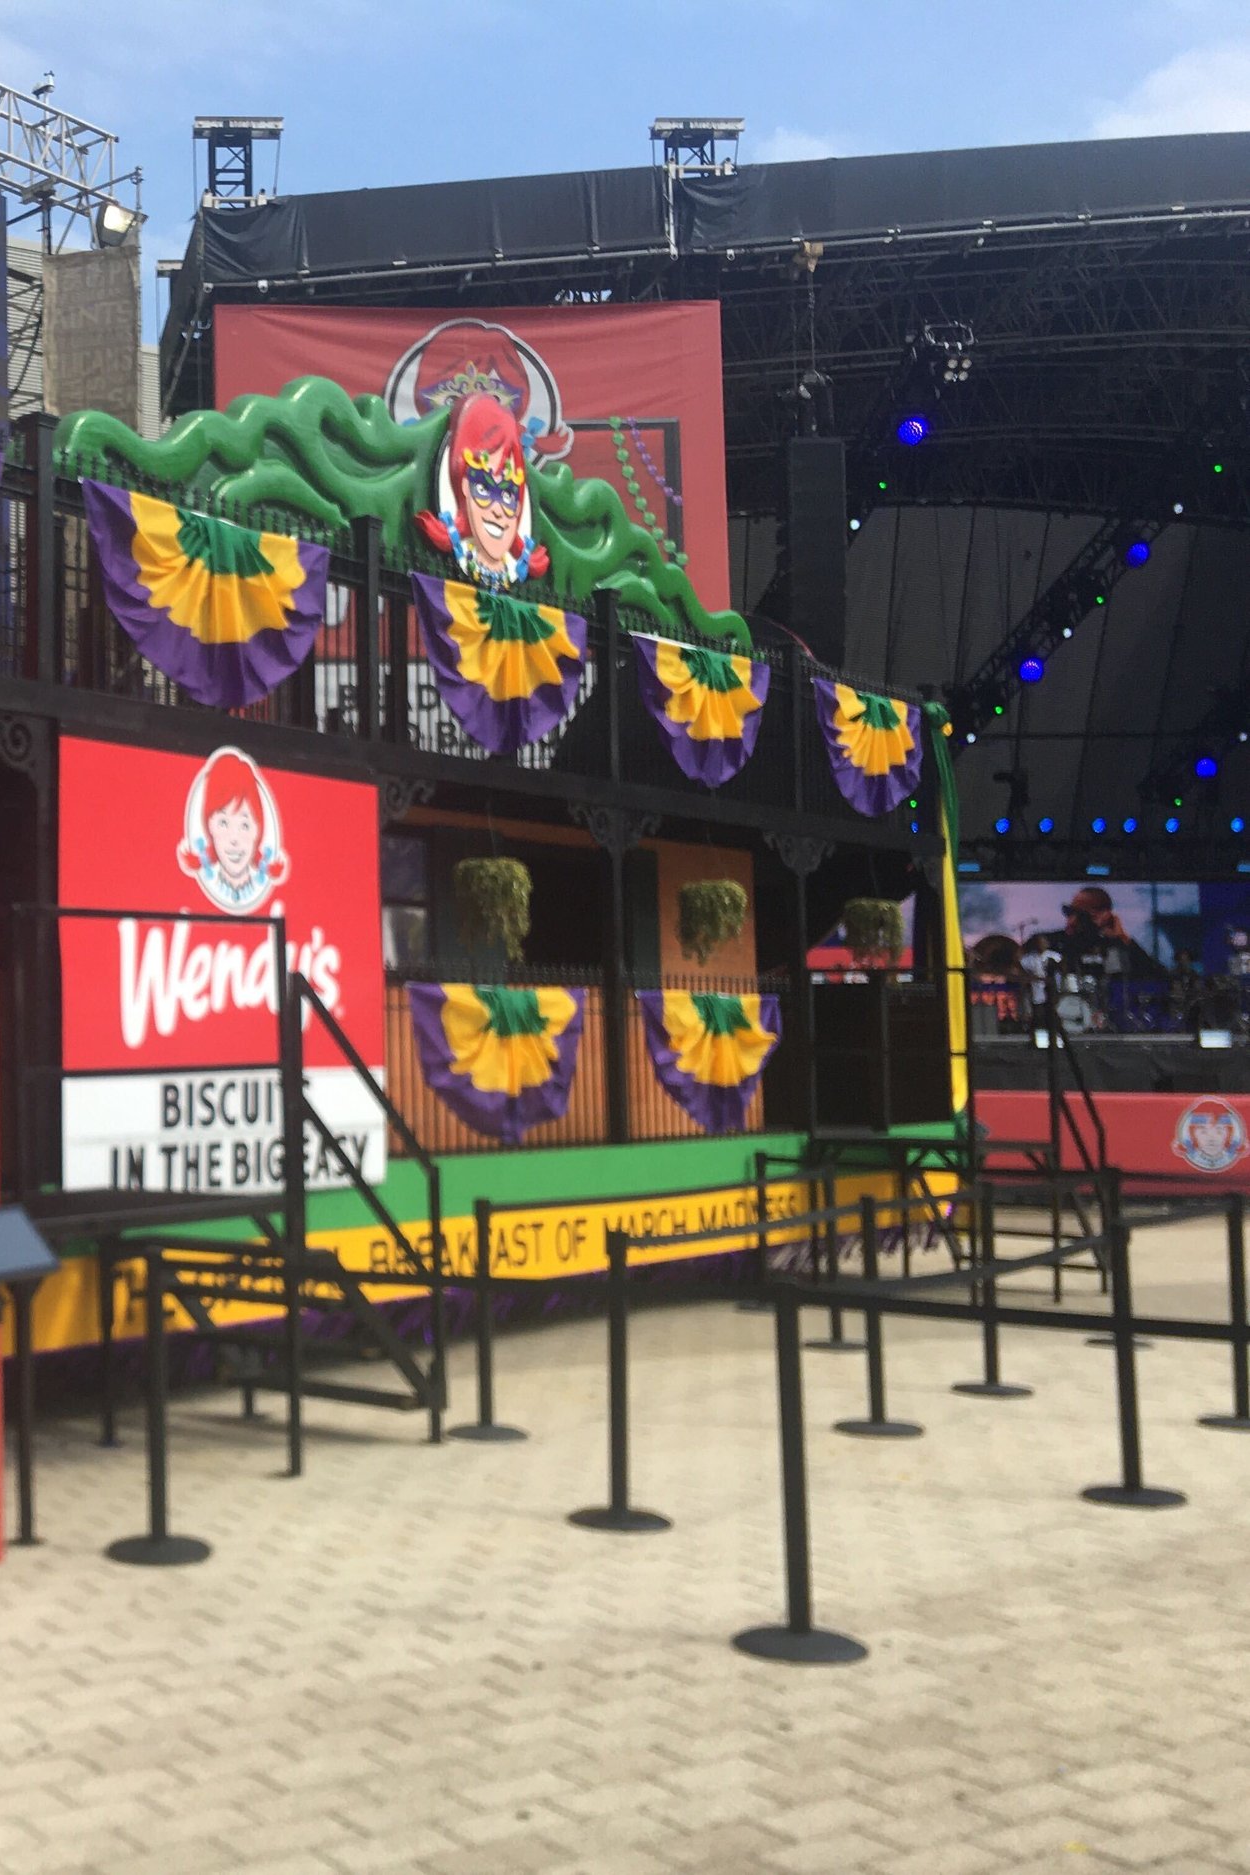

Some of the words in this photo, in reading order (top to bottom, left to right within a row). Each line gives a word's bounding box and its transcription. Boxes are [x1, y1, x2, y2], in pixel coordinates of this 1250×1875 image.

[161, 1080, 309, 1129] BISCUI
[111, 1146, 144, 1190] IN
[161, 1141, 222, 1191] THE
[233, 1137, 286, 1186] BIG
[369, 1222, 544, 1275] BREAKAST
[555, 1217, 587, 1262] OF
